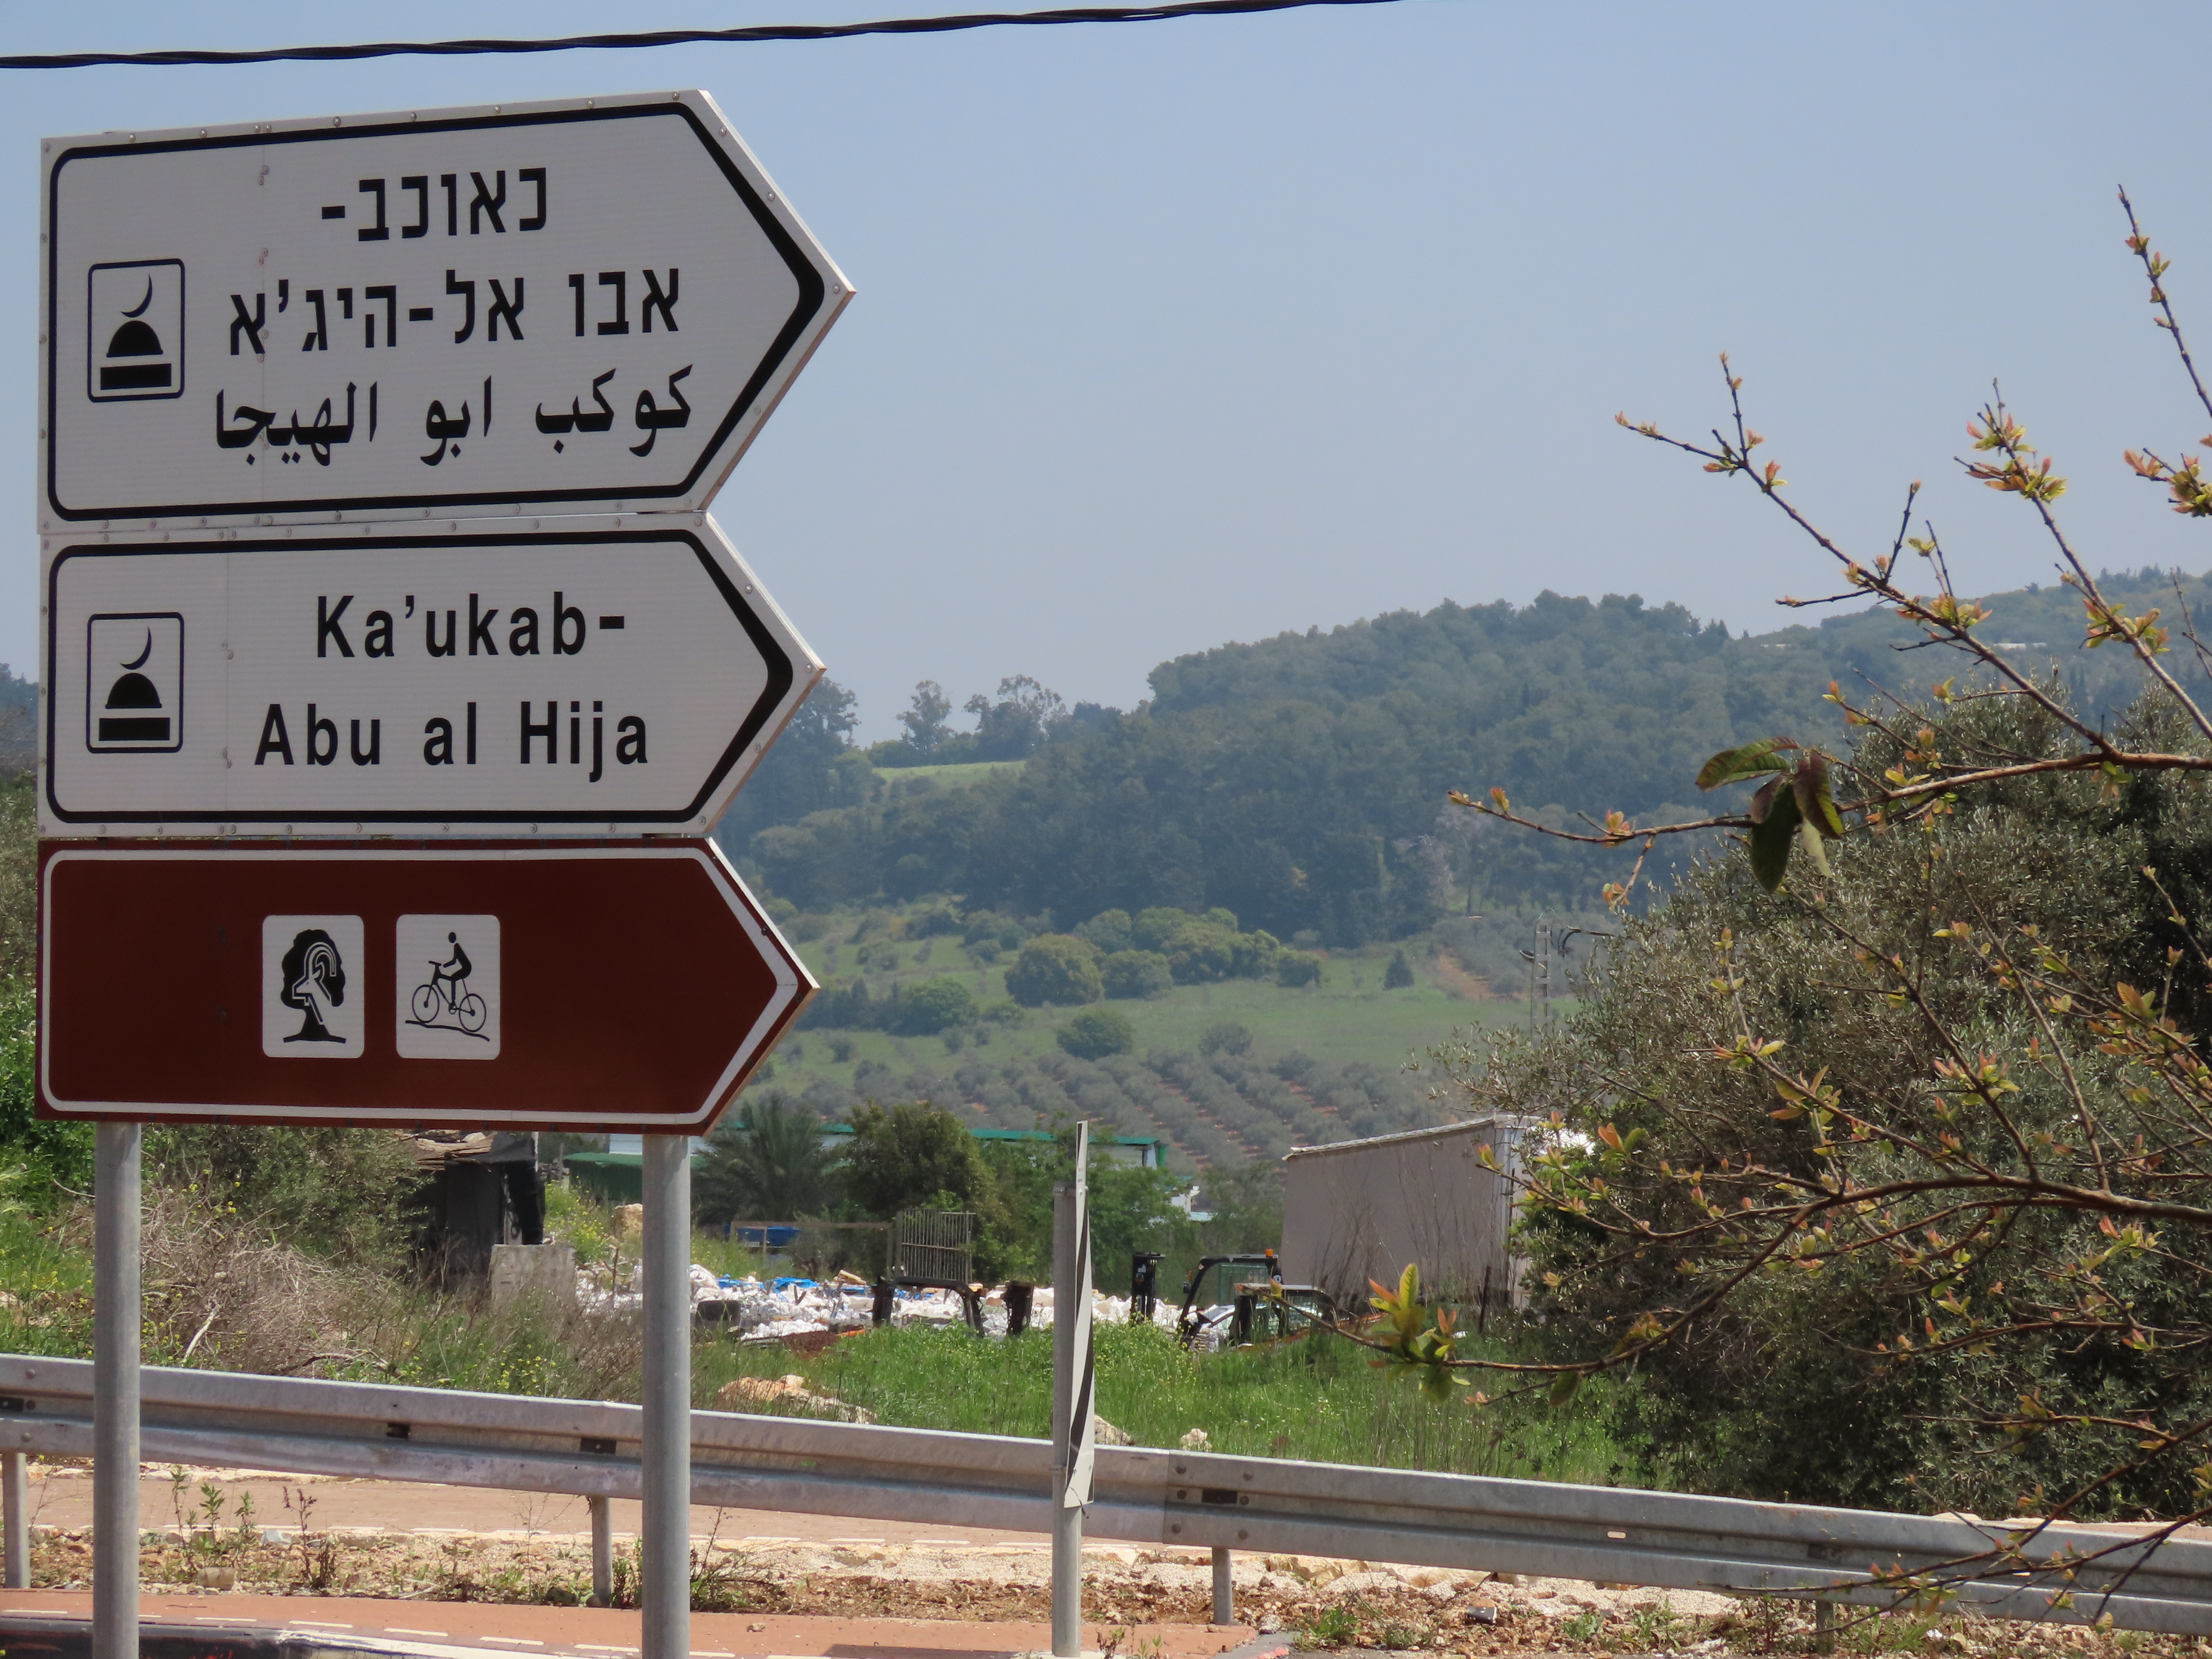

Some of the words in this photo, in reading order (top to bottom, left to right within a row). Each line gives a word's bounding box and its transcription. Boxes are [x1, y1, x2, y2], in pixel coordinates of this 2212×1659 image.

[321, 167, 547, 242] כאוכב-
[568, 268, 679, 338] אבו
[216, 381, 378, 467] الهيجا
[419, 375, 492, 467] ابو
[535, 364, 693, 457] كوكب
[317, 591, 625, 659] Ka'ukab-
[254, 703, 381, 766] Abu
[423, 701, 477, 766] al
[520, 700, 648, 783] Hija
